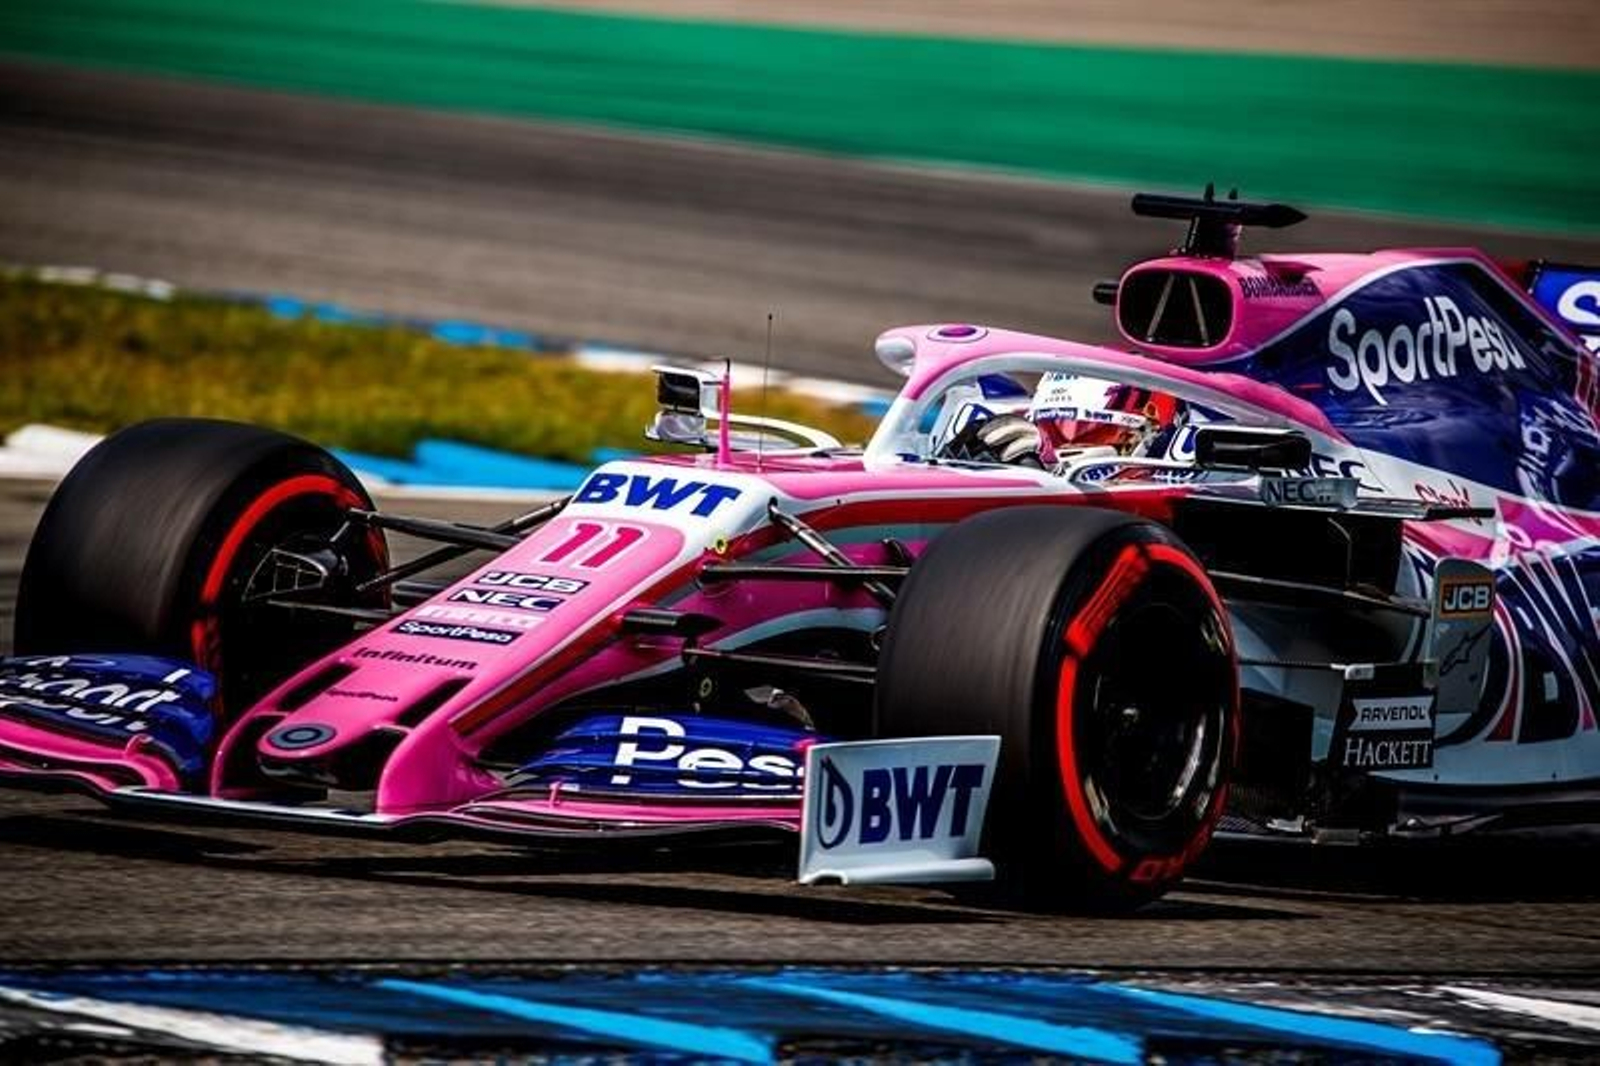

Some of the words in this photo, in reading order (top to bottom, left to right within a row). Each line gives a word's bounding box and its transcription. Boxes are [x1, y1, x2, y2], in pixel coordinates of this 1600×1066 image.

[571, 472, 742, 518] BWT
[1266, 479, 1318, 502] NEC
[539, 522, 645, 568] 11
[478, 570, 586, 594] JCB
[449, 588, 563, 612] NEC
[1442, 585, 1490, 611] JCB
[399, 620, 514, 645] SportPesa
[1360, 703, 1428, 723] RAVENOL
[609, 715, 805, 791] Pes
[1342, 737, 1433, 768] HACKETT
[858, 763, 987, 845] BWT
